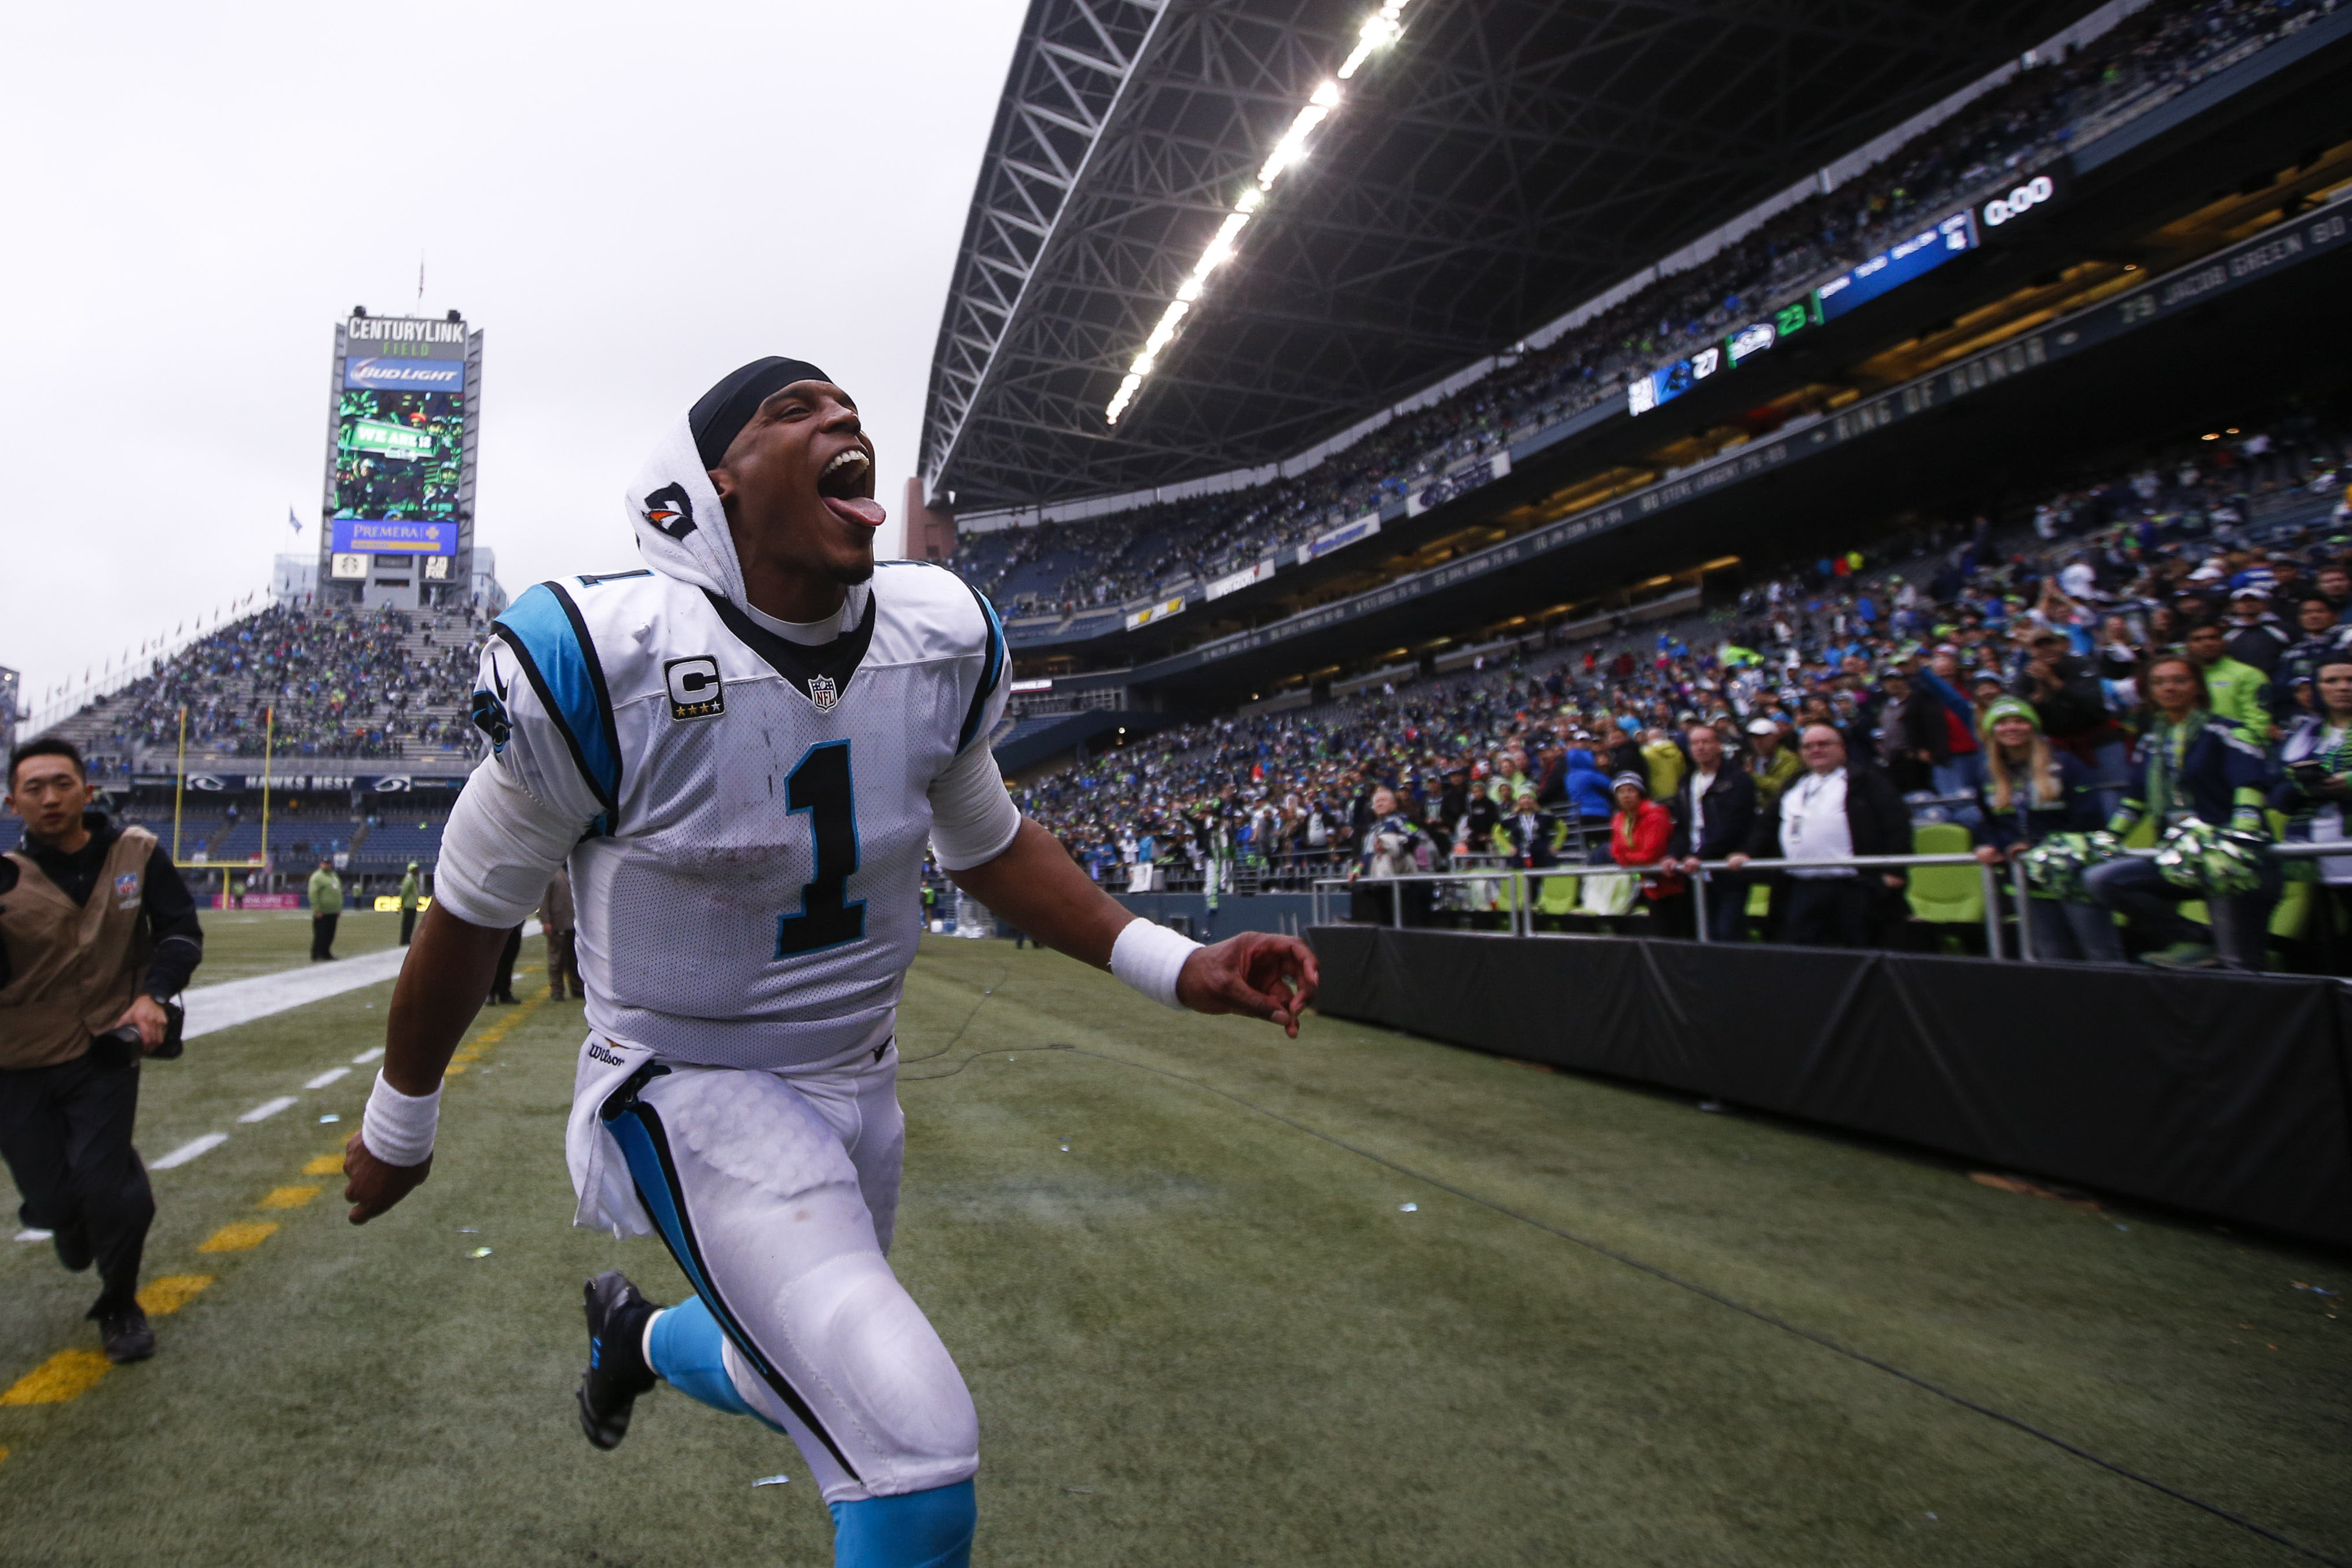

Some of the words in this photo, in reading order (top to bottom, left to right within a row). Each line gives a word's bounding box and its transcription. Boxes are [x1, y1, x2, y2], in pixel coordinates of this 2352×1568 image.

[1983, 176, 2054, 226] 0:00
[2229, 233, 2304, 277] GREEN
[349, 317, 464, 343] CENTURYLINK
[1775, 304, 1807, 337] 23
[383, 342, 430, 356] FIELD
[1691, 347, 1719, 380] 27
[400, 368, 457, 382] LIGHT
[1902, 379, 1935, 413] OF
[1949, 335, 2047, 397] HONOR
[353, 523, 418, 538] PREMERA
[668, 660, 719, 704] C
[815, 691, 834, 705] NFL
[246, 775, 306, 790] HAWKS
[312, 776, 354, 790] NEST
[774, 738, 866, 959] 1
